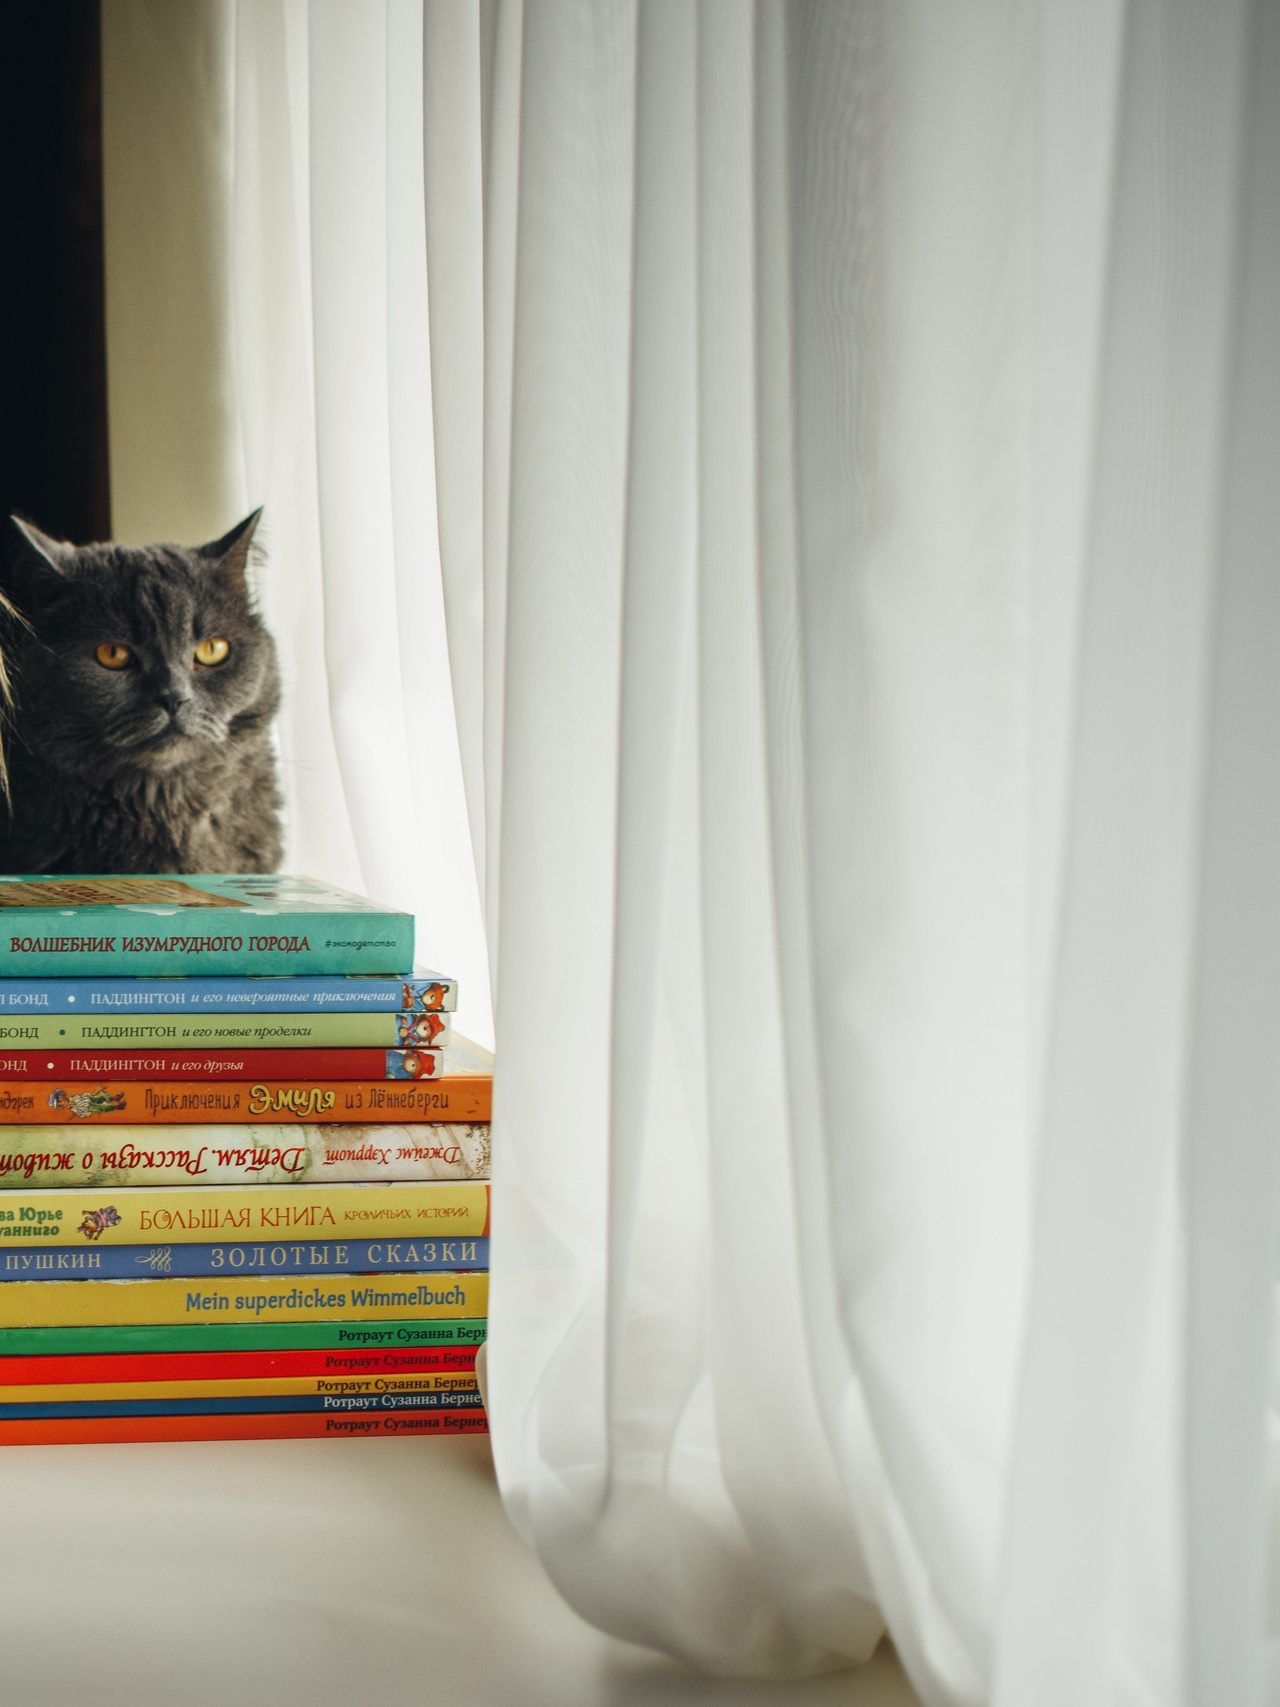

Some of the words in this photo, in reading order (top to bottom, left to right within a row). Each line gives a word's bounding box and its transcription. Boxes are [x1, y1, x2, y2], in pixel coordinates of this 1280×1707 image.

[10, 936, 116, 952] ВОЛШЕБНИК
[122, 936, 242, 954] ИЗУМРУДНОГО
[248, 936, 311, 953] ГОРОДА
[8, 993, 49, 1007] БОНД
[91, 992, 186, 1007] ПАДДИНГТОН
[190, 994, 200, 1003] и
[203, 994, 223, 1003] его
[226, 992, 309, 1005] невероятные
[312, 992, 396, 1005] приключения
[0, 1027, 40, 1040] БОНД
[81, 1025, 177, 1040] ПАДДИНГТОН
[182, 1028, 190, 1037] и
[192, 1028, 213, 1037] его
[214, 1028, 252, 1037] новые
[253, 1026, 312, 1041] проделки
[70, 1059, 166, 1073] ПАДДИНГТОН
[171, 1061, 179, 1070] и
[181, 1061, 202, 1070] его
[203, 1059, 244, 1073] друзья
[145, 1088, 240, 1117] Приключения
[248, 1084, 336, 1117] Эмиля
[346, 1093, 362, 1109] из
[368, 1088, 450, 1115] Лённеберги
[82, 1152, 93, 1169] о
[101, 1144, 208, 1176] Рассказы
[212, 1147, 306, 1173] Детям.
[322, 1144, 392, 1165] Хэрриот
[395, 1146, 460, 1164] Джеймс
[19, 1207, 63, 1224] Юрье
[140, 1208, 251, 1230] БОЛЬШАЯ
[260, 1206, 336, 1226] КНИГА
[344, 1208, 412, 1220] КРОЛИЧЬИХ
[417, 1206, 469, 1219] ИСТОРИЙ
[5, 1253, 102, 1270] ПУШКИН
[211, 1245, 350, 1268] ЗОЛОТЫЕ
[368, 1242, 478, 1264] СКАЗКИ
[186, 1292, 229, 1311] Mein
[235, 1288, 346, 1315] superdickes
[351, 1285, 465, 1306] Wimmelbuch
[338, 1329, 394, 1343] Ротраут
[397, 1328, 453, 1342] Сузанна
[326, 1356, 381, 1369] Ротраут
[384, 1354, 439, 1368] Сузанна
[317, 1380, 372, 1394] Ротраут
[374, 1379, 431, 1392] Сузанна
[323, 1396, 378, 1409] Ротраут
[381, 1394, 438, 1408] Сузанна
[326, 1419, 380, 1433] Ротраут
[384, 1418, 440, 1431] Сузанна
